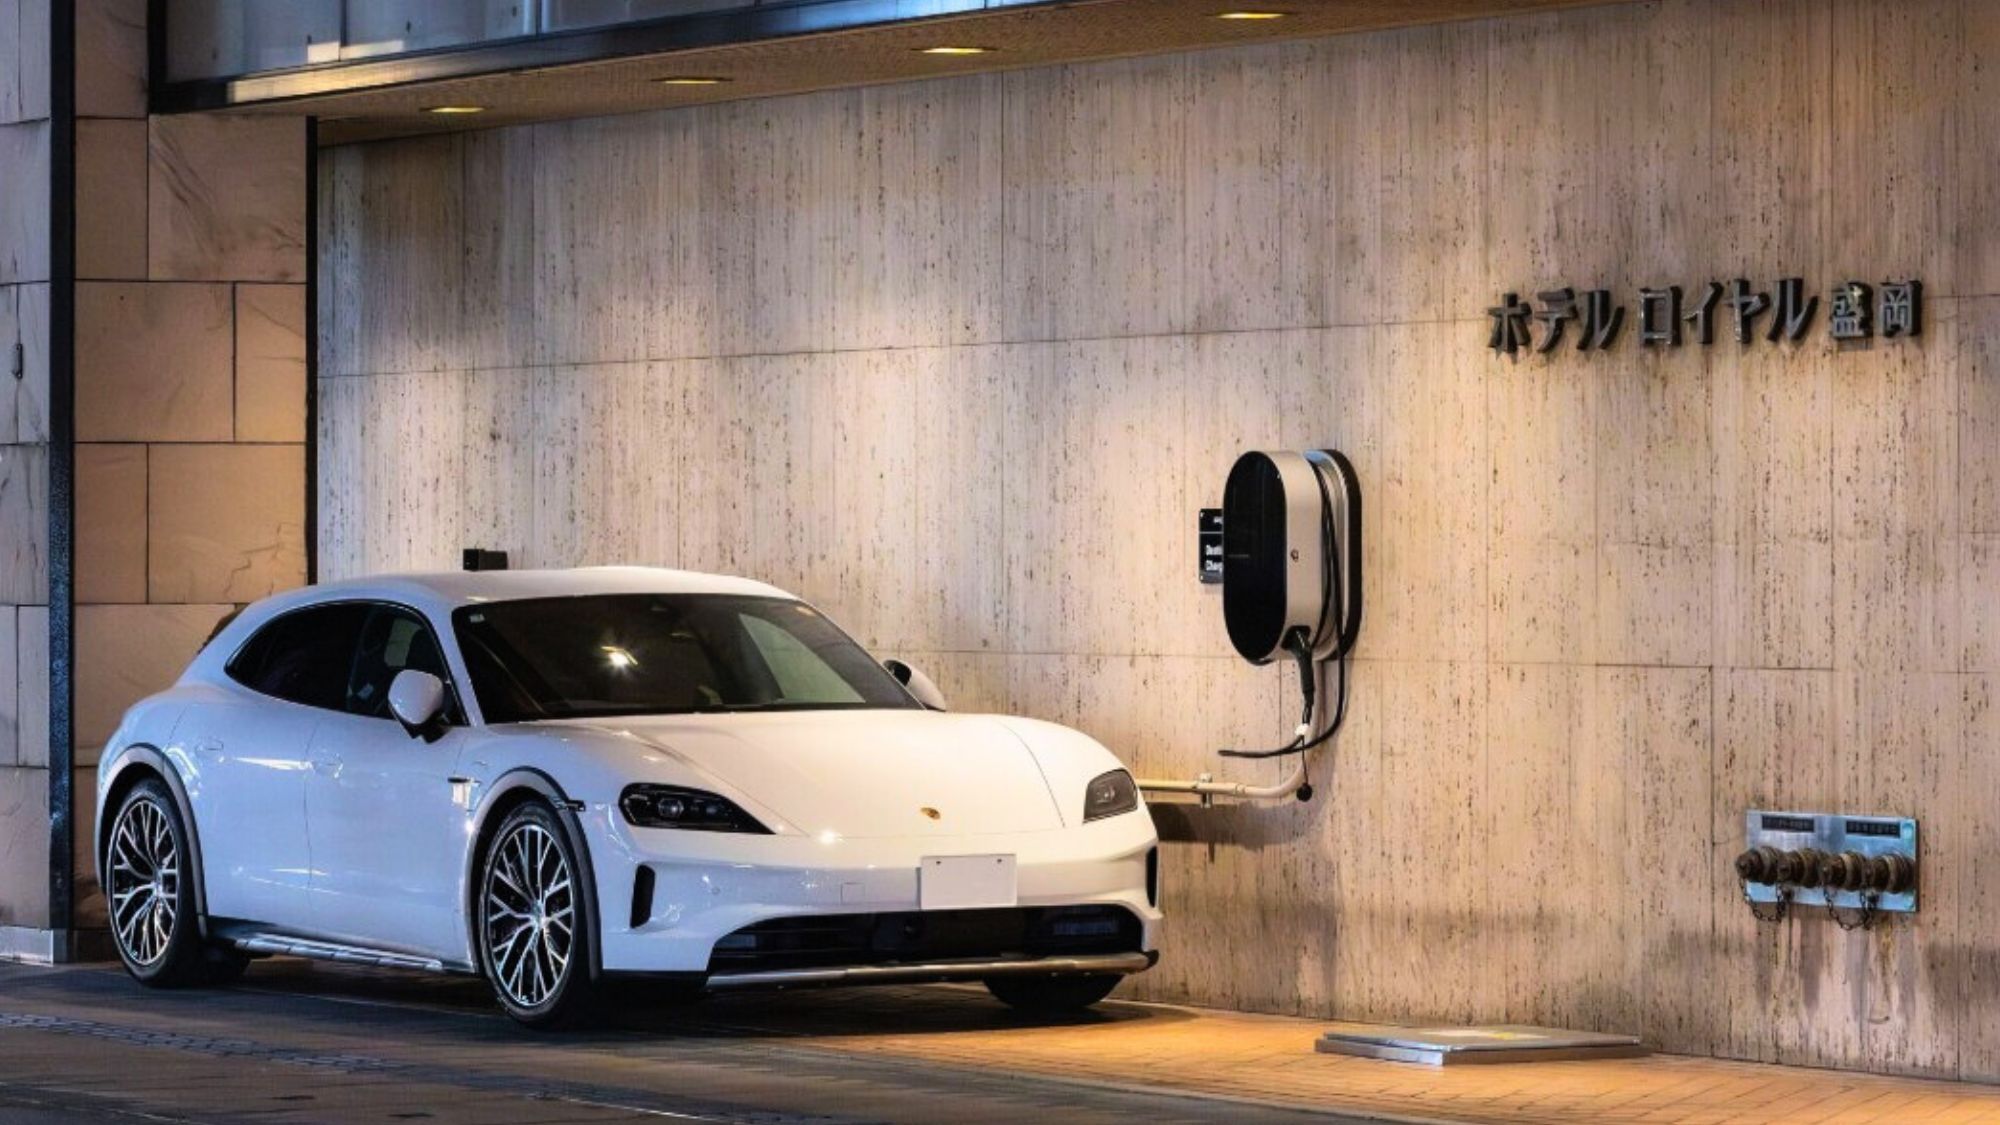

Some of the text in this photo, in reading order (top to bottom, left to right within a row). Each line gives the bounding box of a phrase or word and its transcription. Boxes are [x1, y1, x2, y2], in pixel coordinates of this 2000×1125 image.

[1488, 278, 1923, 353] ホテル ロイヤル 盛岡
